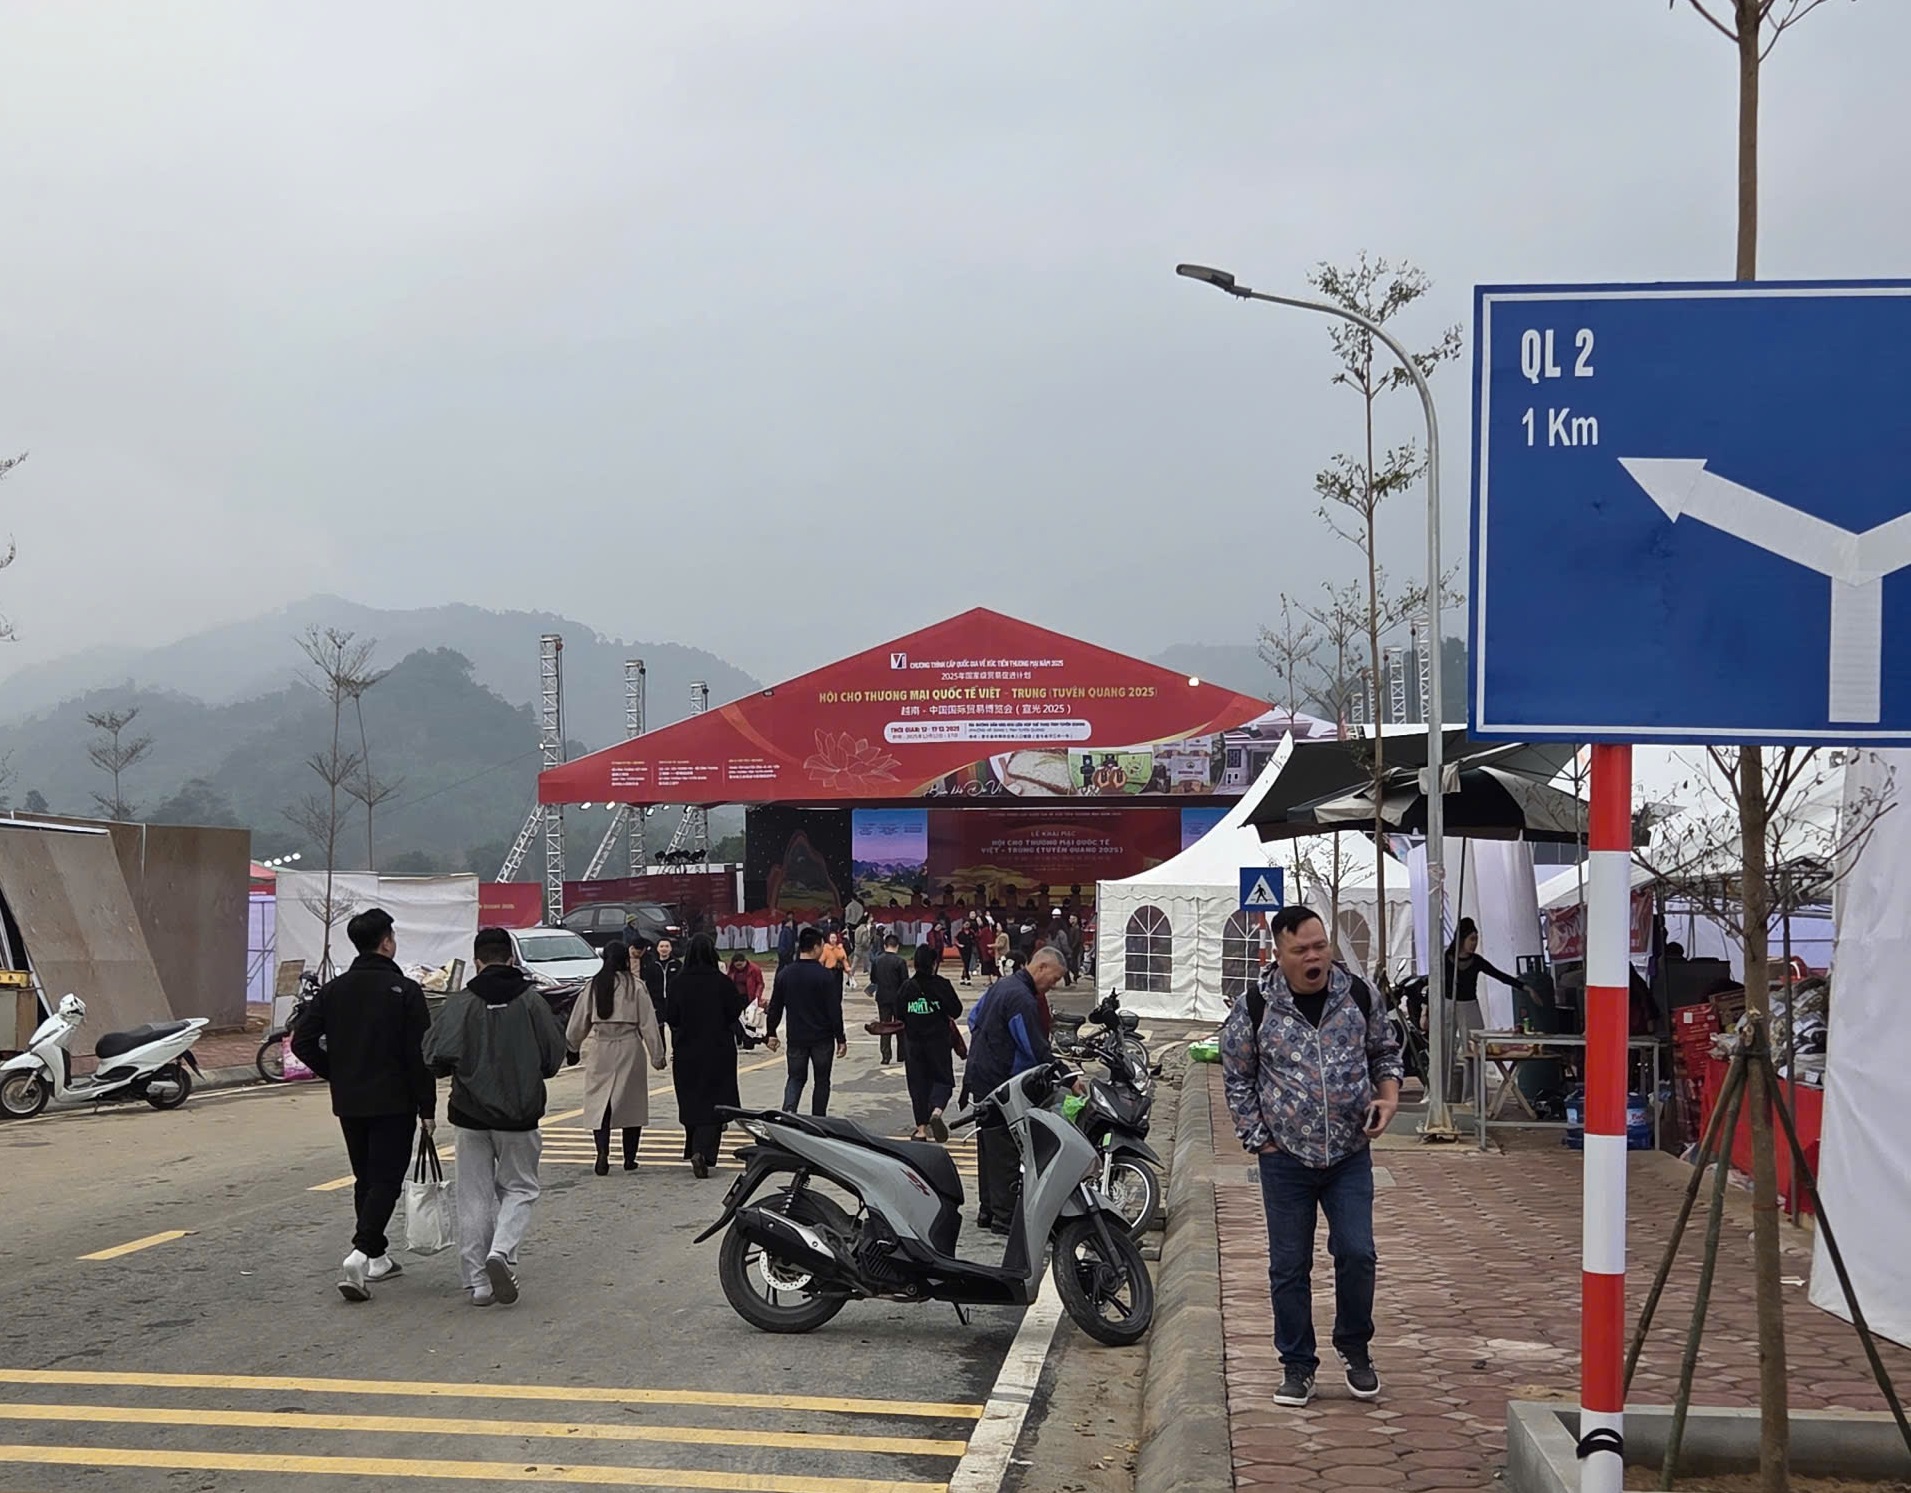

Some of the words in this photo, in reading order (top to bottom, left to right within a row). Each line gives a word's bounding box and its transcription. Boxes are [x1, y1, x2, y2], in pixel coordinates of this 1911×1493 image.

[1521, 329, 1561, 384] QL
[1574, 328, 1594, 377] 2
[1522, 407, 1534, 446] 1
[1548, 407, 1598, 447] Km
[819, 690, 838, 704] HỘI
[840, 690, 862, 703] CHỢ
[864, 689, 907, 702] THƯƠNG
[909, 689, 930, 702] MẠI
[932, 685, 962, 701] QUỐC
[964, 685, 978, 699] TẾ
[978, 686, 1001, 701] VIỆT
[1011, 688, 1047, 699] TRUNG
[1087, 686, 1126, 698] QUANG
